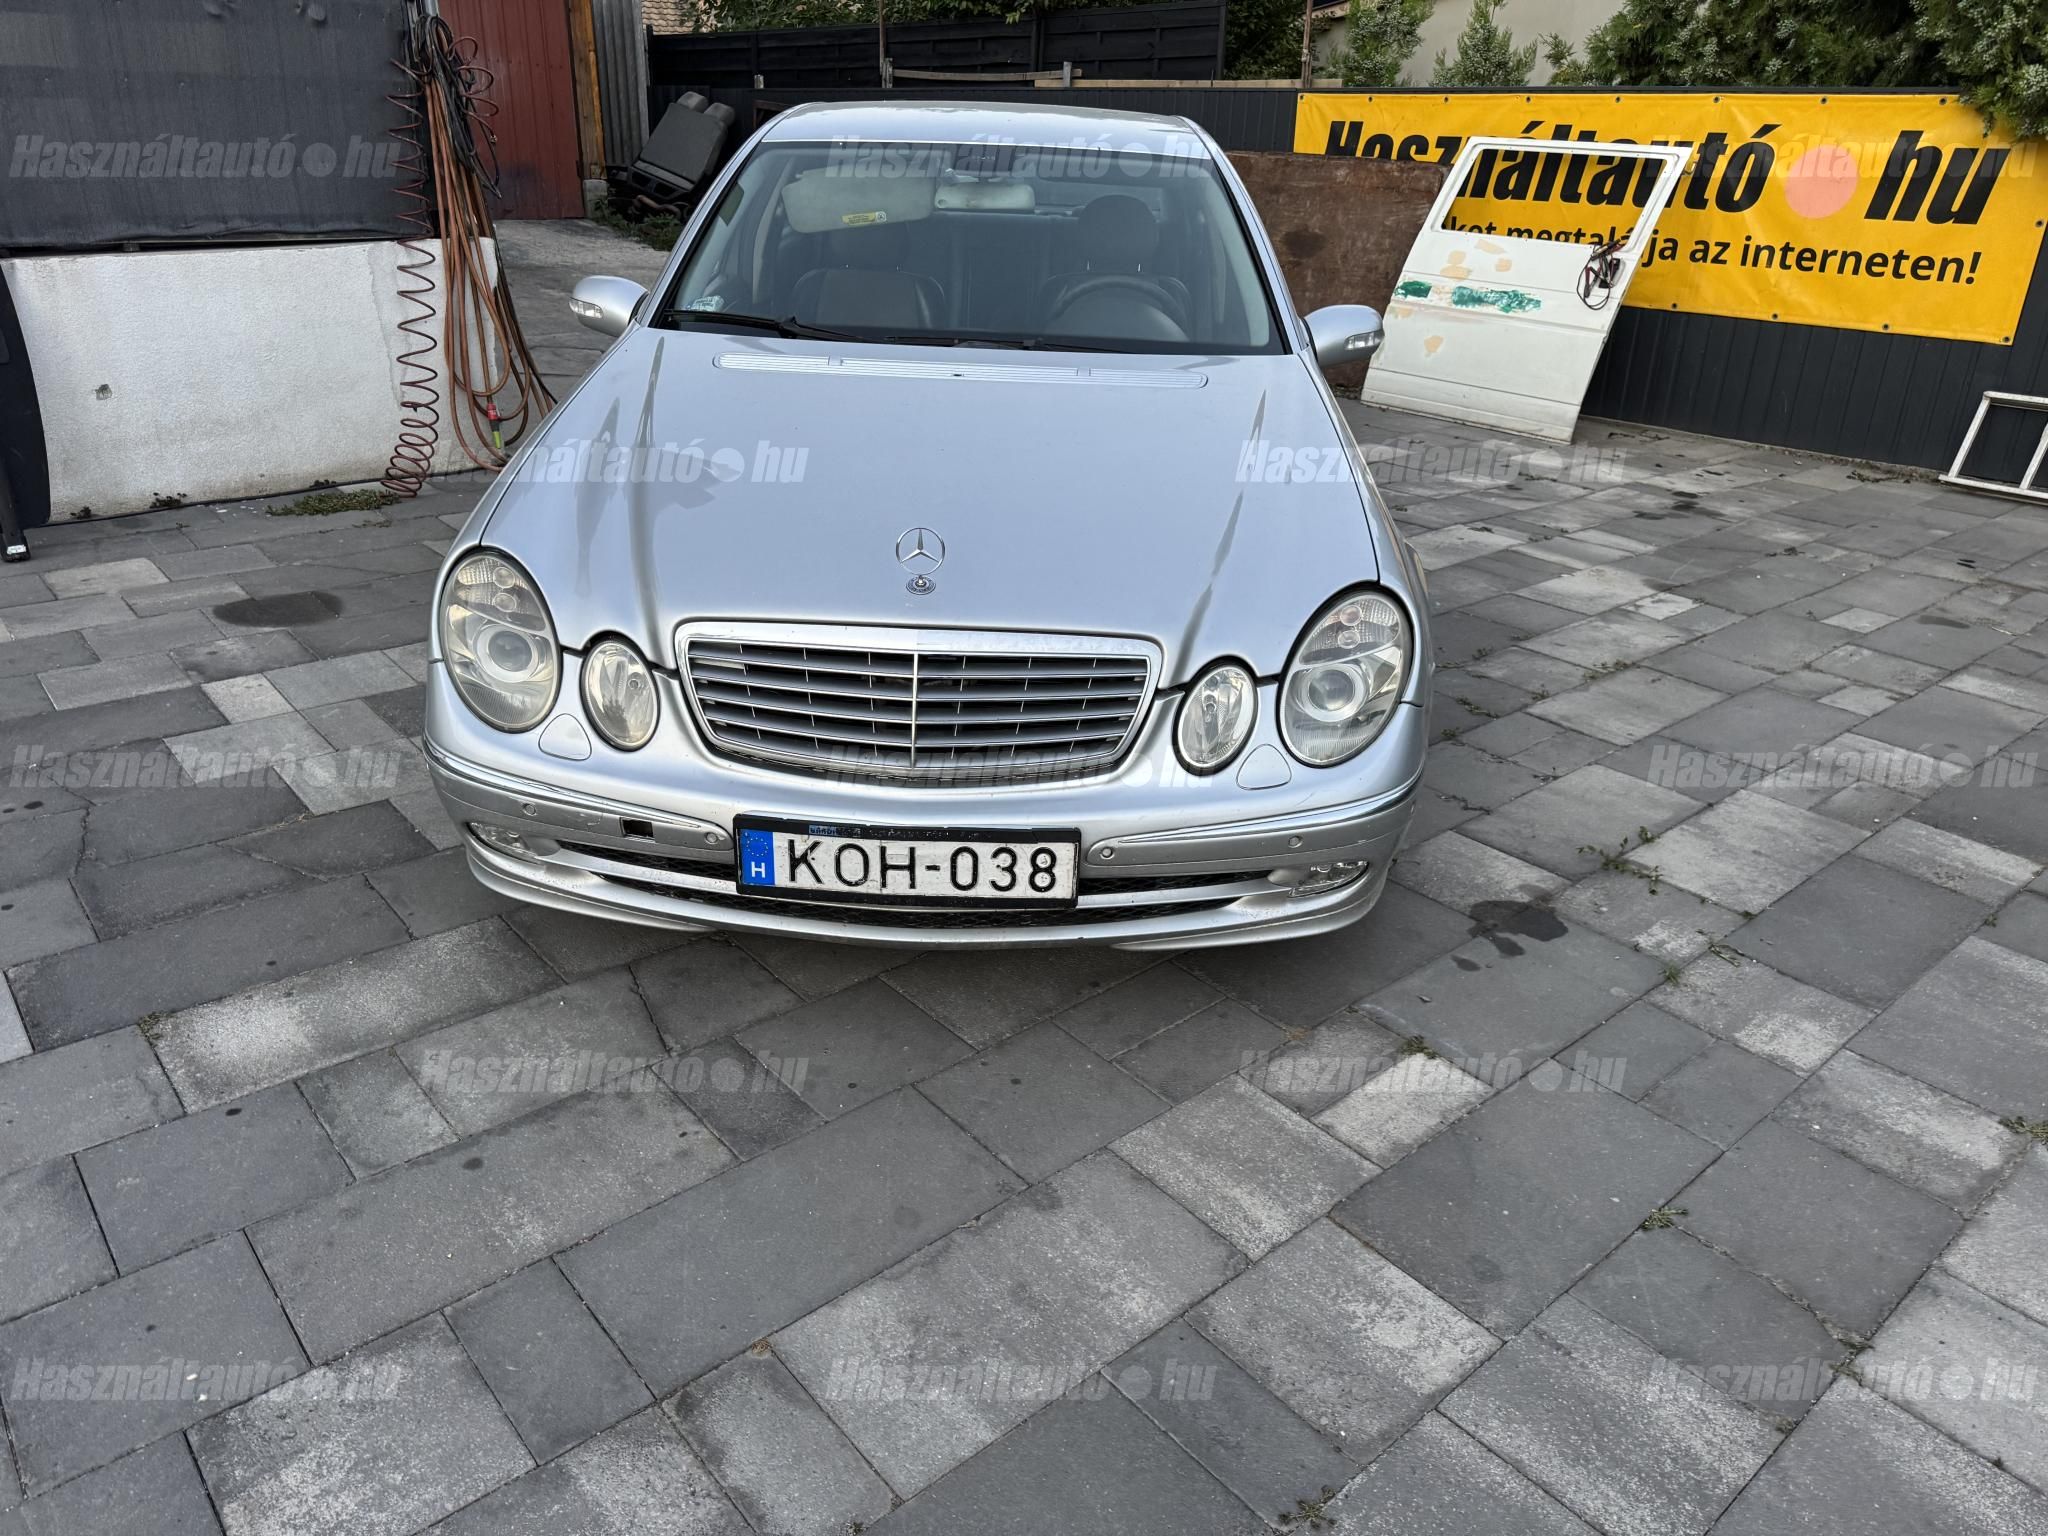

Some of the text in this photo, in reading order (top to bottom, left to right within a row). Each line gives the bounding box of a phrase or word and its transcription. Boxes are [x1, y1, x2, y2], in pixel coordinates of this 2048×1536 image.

[1864, 130, 2012, 225] hu
[1689, 240, 1729, 266] az
[1741, 235, 1982, 285] interneten!
[751, 861, 766, 879] H
[787, 838, 1057, 893] KOH-038
